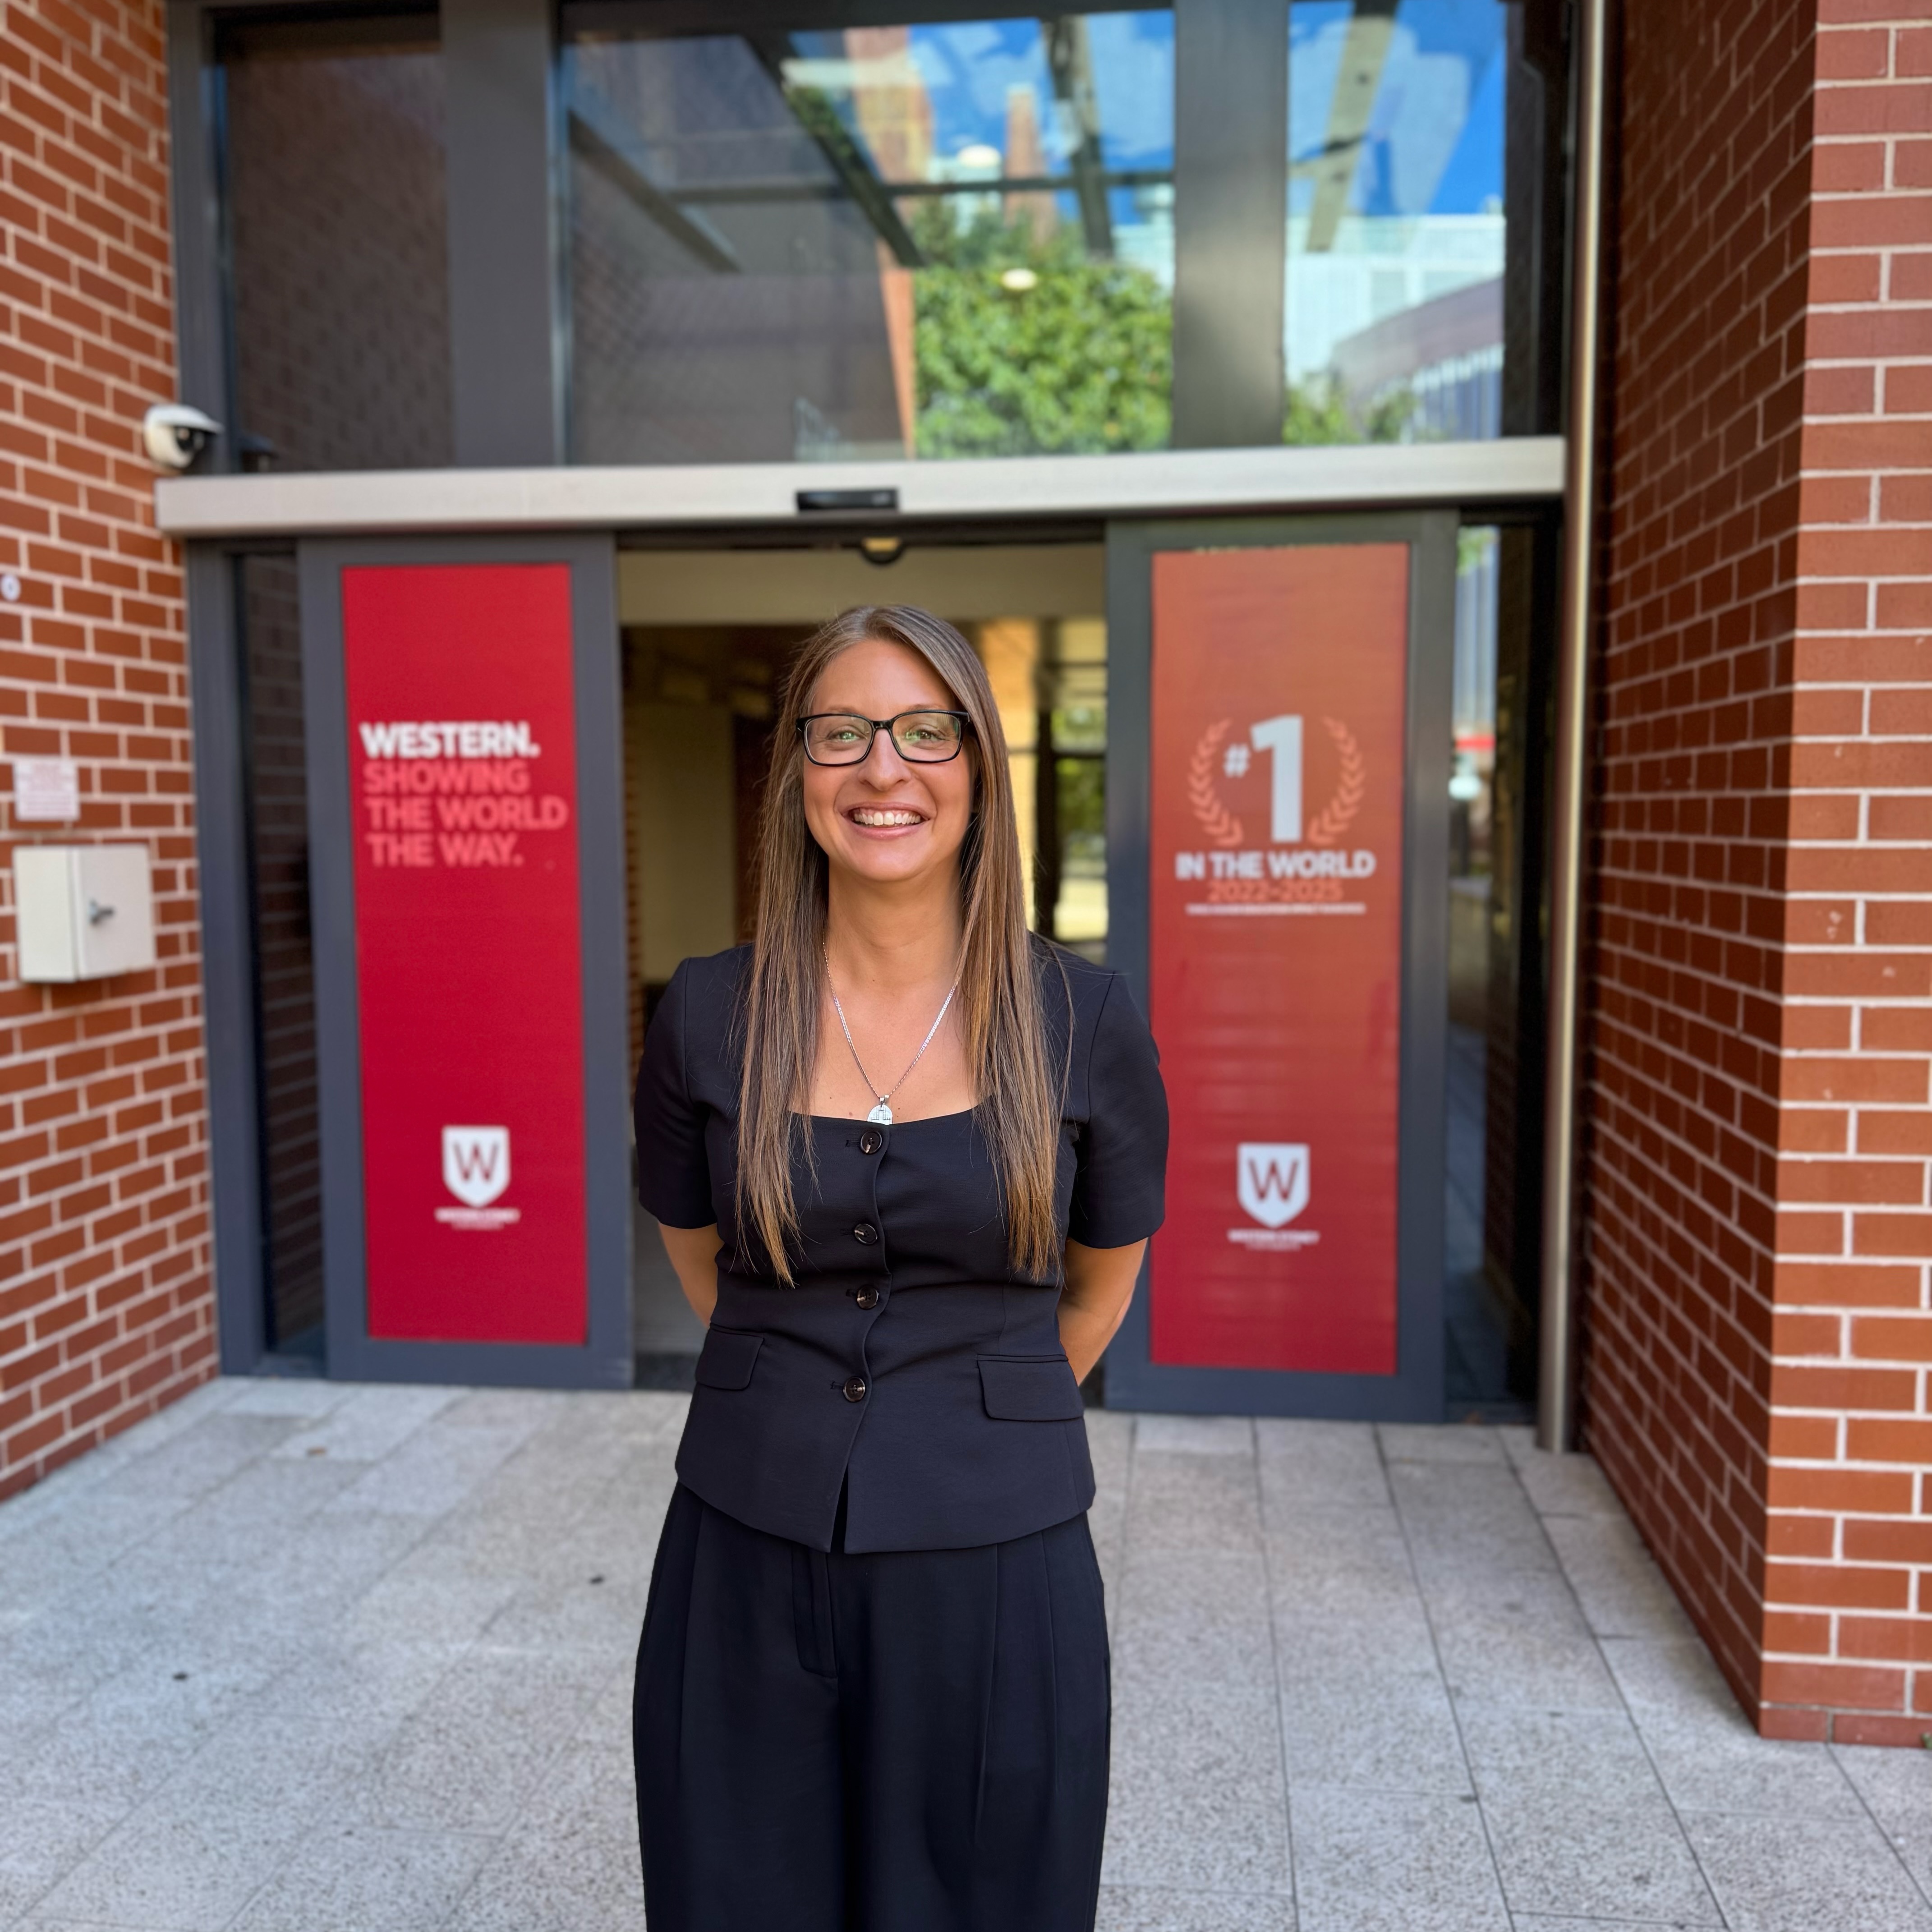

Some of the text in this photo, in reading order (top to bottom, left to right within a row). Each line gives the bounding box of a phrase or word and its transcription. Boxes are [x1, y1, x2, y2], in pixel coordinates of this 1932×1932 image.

[359, 721, 541, 758] WESTERN.
[363, 759, 530, 793] SHOWING
[1223, 715, 1302, 842] #1
[365, 795, 569, 829] THE WORLD
[365, 832, 524, 866] THE WAY.
[1176, 850, 1376, 880] IN THE WORLD
[453, 1141, 499, 1182] W
[1248, 1159, 1299, 1203] W
